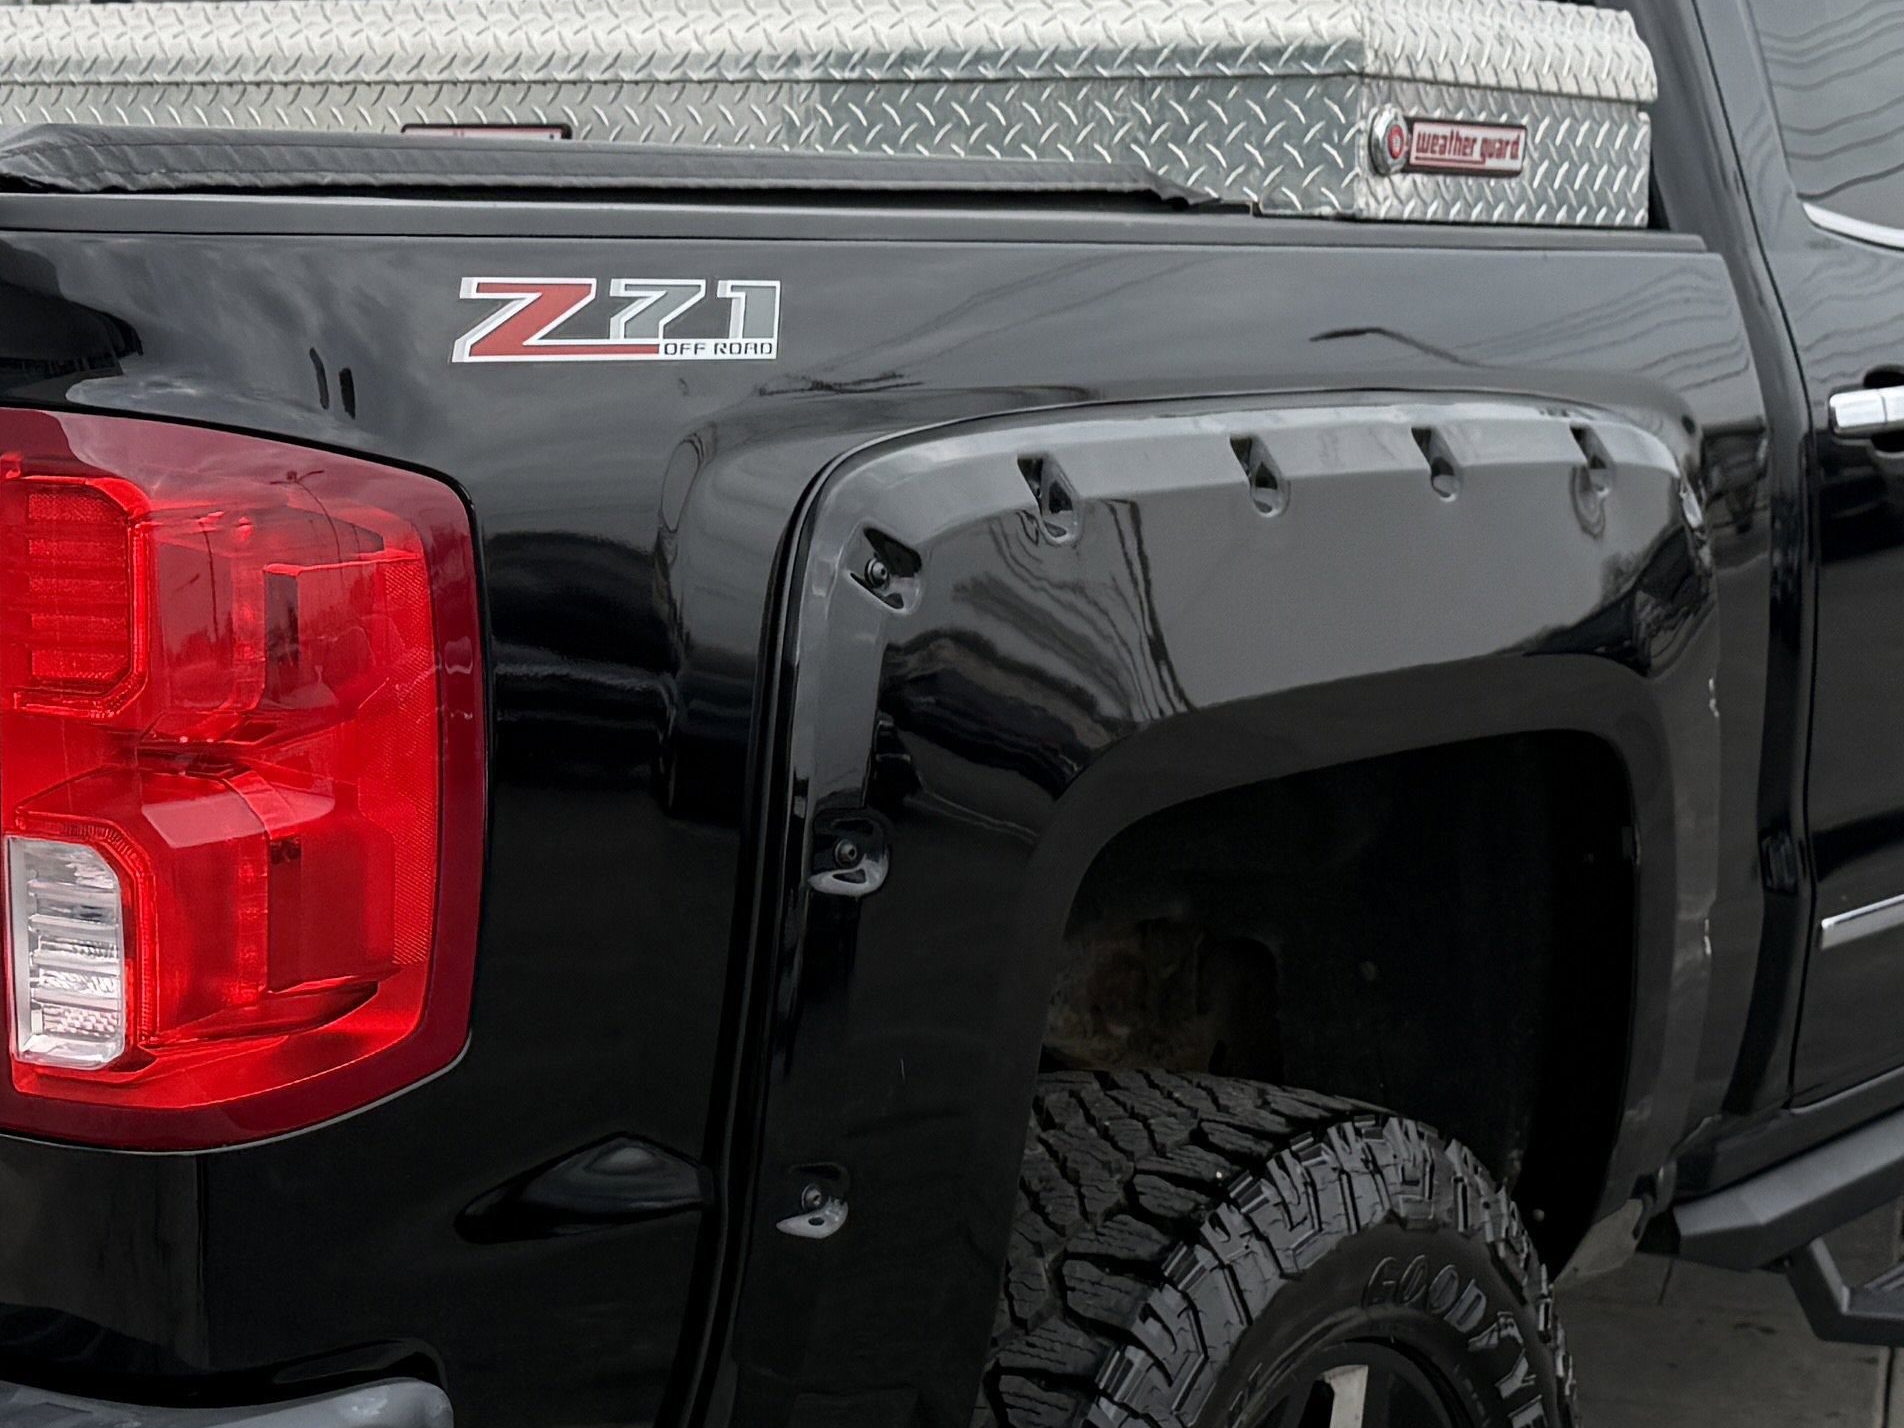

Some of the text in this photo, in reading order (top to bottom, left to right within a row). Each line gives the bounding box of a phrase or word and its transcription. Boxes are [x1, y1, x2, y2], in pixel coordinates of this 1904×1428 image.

[1415, 129, 1521, 162] weather guard
[449, 276, 781, 363] Z71
[663, 341, 774, 356] OFF ROAD
